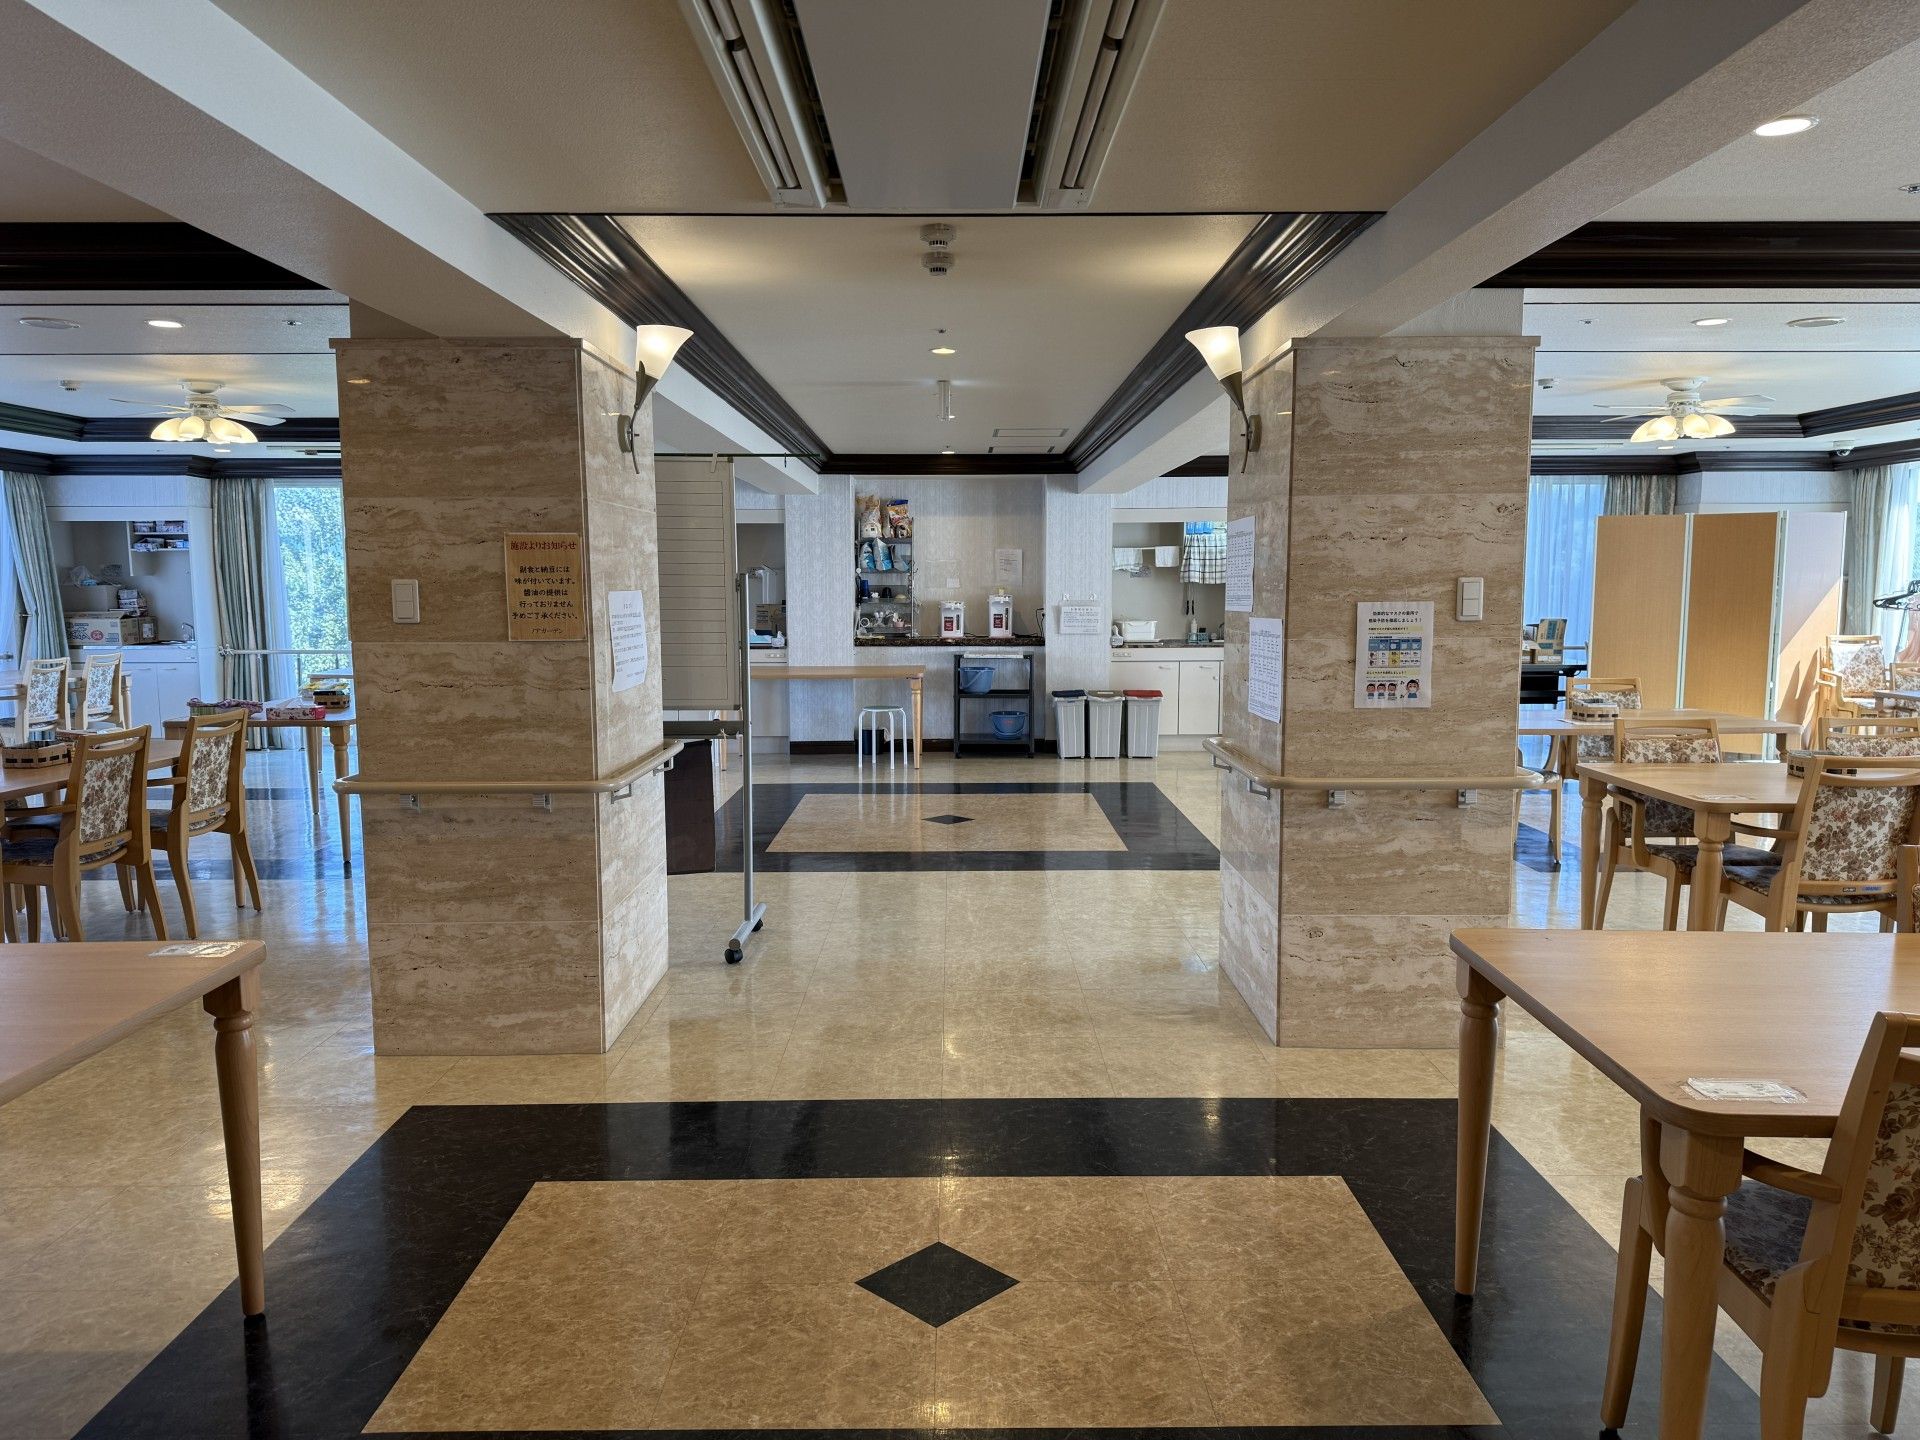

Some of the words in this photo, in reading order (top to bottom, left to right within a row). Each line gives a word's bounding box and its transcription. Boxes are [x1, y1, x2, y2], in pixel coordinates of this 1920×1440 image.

[510, 541, 577, 551] 施設よりお知らせ
[514, 577, 576, 585] 味が付いています。
[519, 600, 573, 608] 行っておりません
[511, 612, 578, 620] 予めご了承ください。
